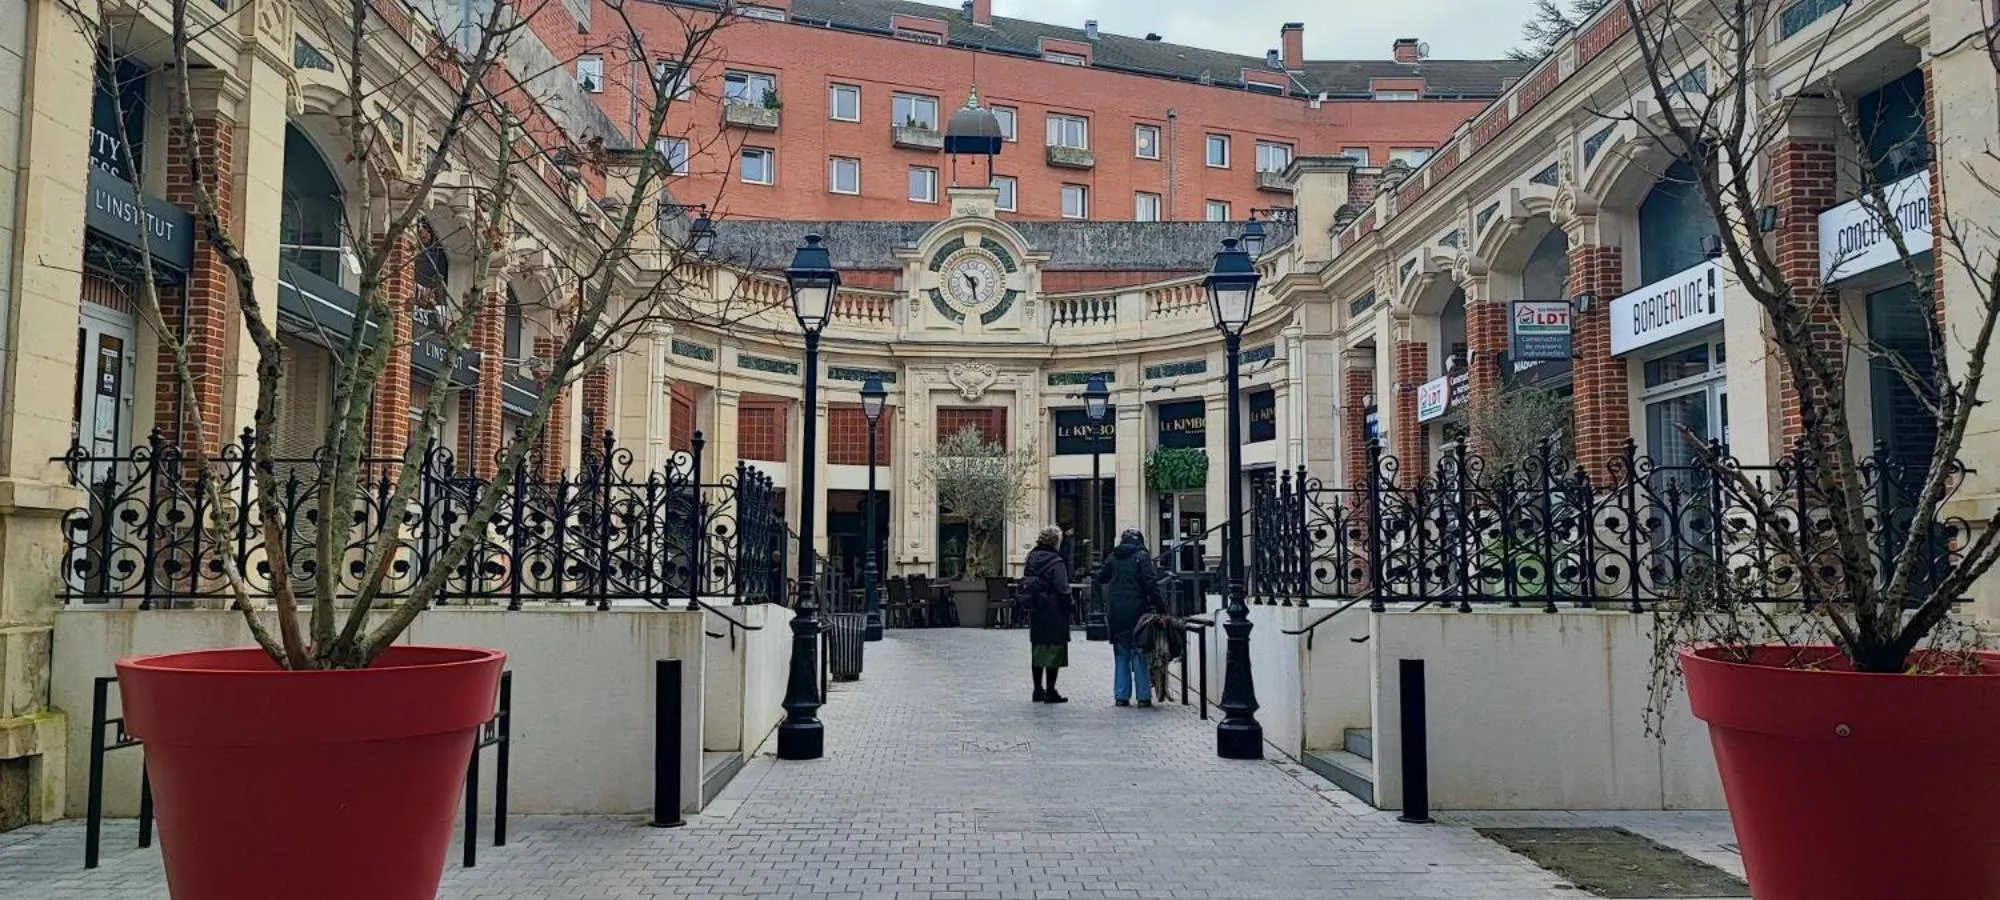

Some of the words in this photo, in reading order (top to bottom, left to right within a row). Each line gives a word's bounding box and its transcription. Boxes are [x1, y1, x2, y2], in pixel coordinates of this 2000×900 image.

[96, 189, 174, 240] L'INSTTUT
[1537, 313, 1567, 325] LDT
[1633, 278, 1703, 335] BORDERLINE
[1174, 416, 1205, 431] KIMB
